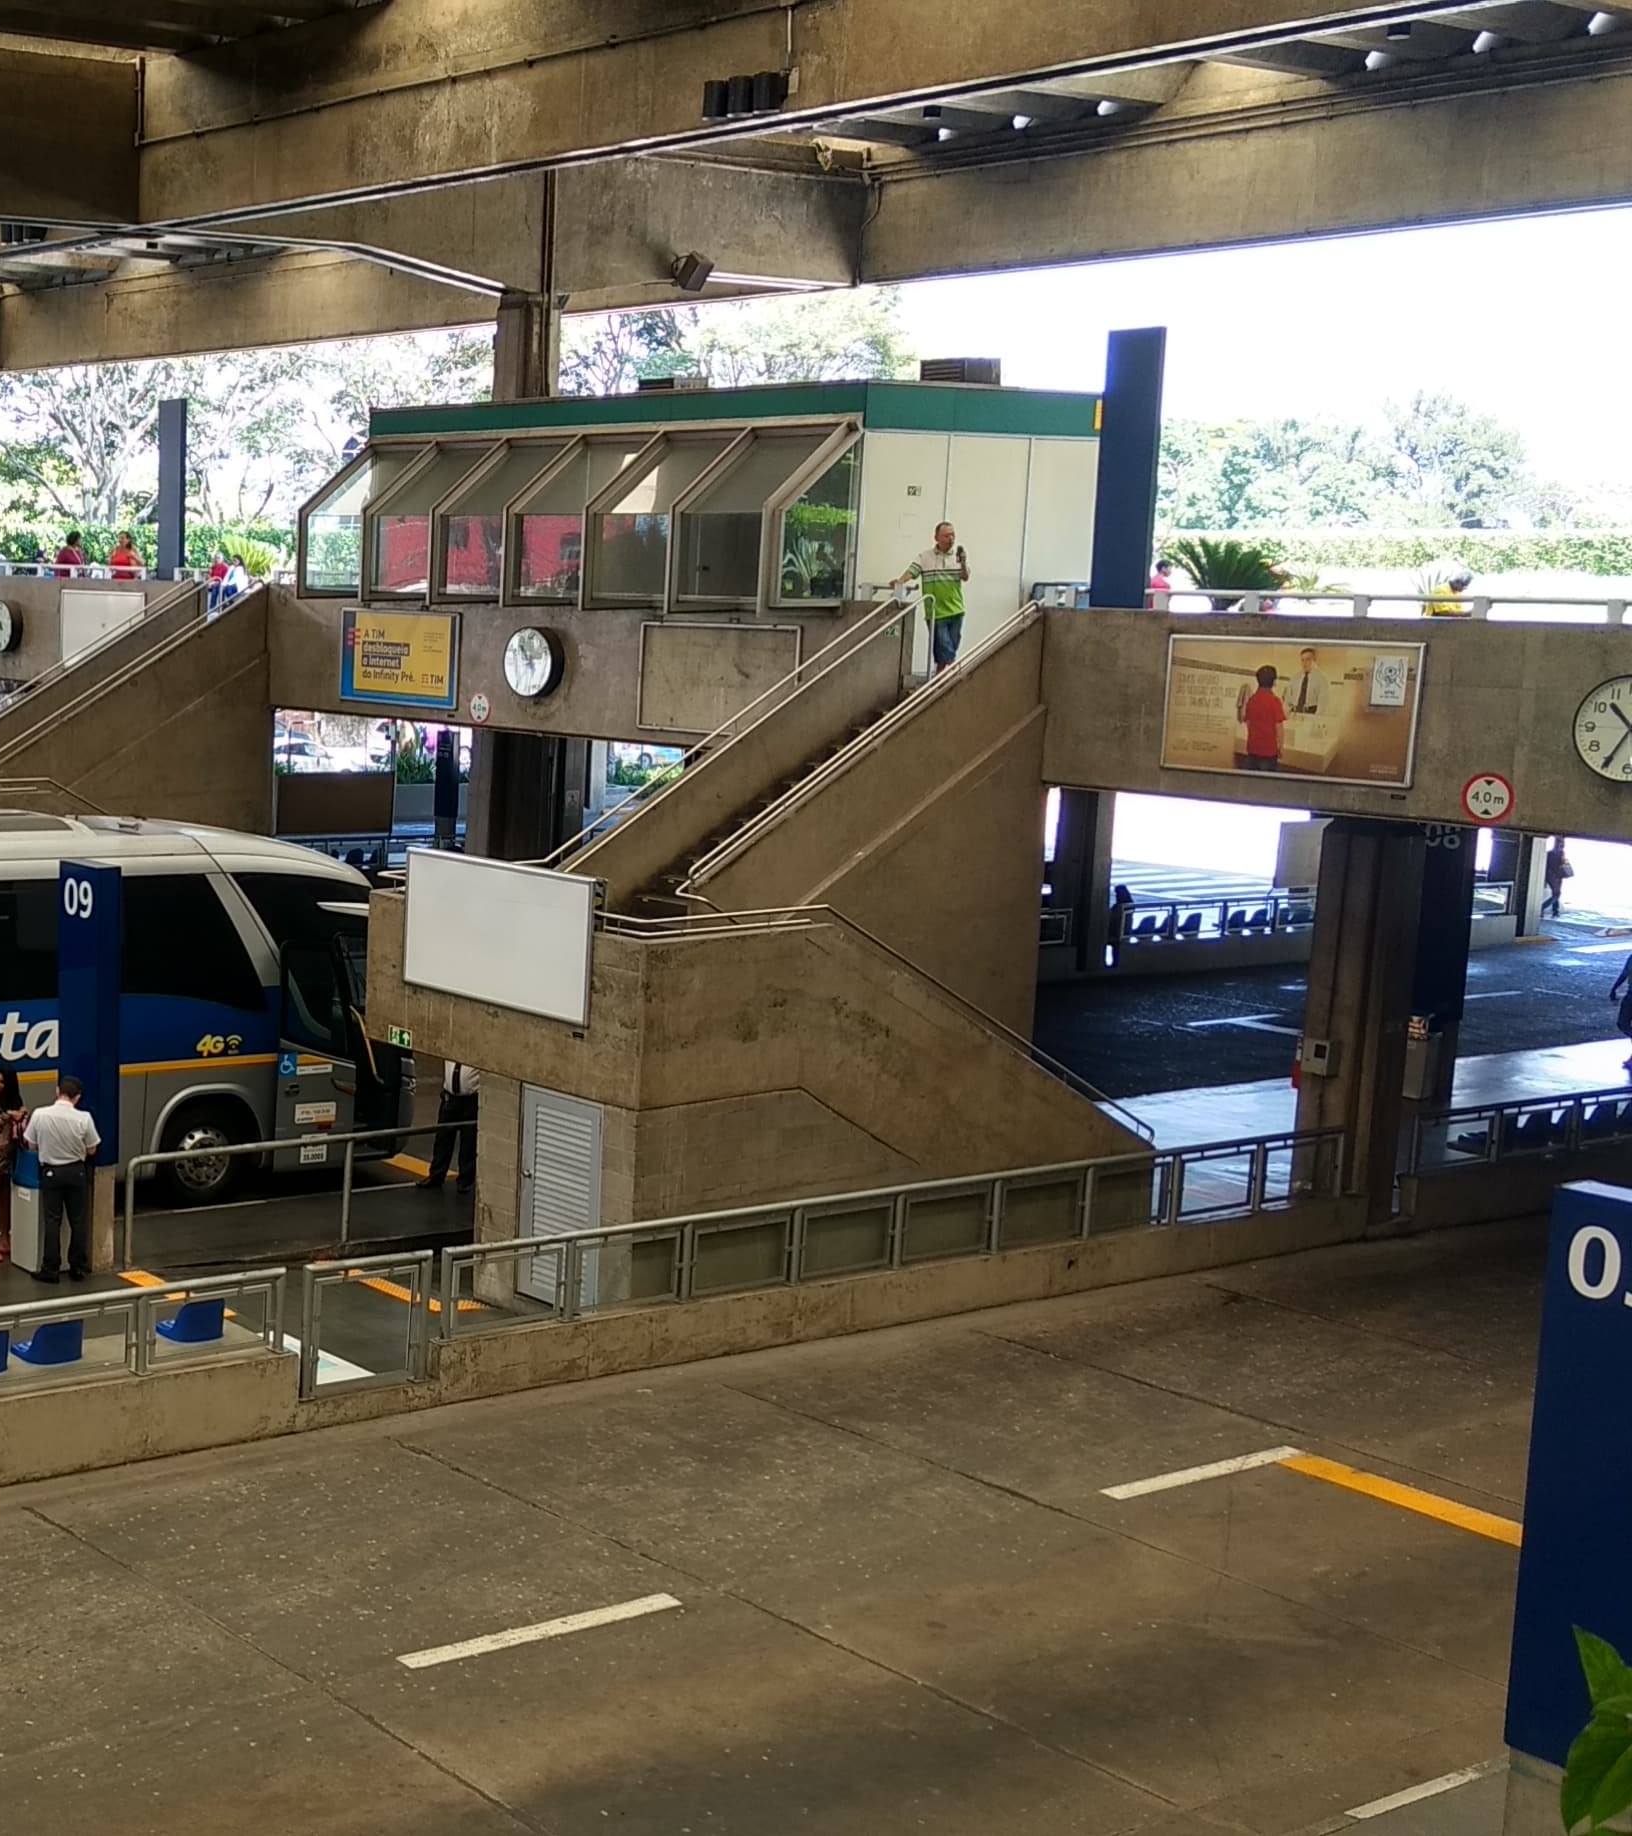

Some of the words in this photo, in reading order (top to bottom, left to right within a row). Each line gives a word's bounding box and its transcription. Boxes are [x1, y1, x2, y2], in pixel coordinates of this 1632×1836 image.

[371, 629, 386, 640] TIM
[362, 669, 372, 679] do
[373, 670, 399, 683] Infinity
[430, 674, 444, 684] TIM
[1611, 688, 1622, 701] 11
[1593, 702, 1608, 714] 10
[1584, 721, 1596, 733] 9
[1588, 740, 1600, 752] 8
[64, 877, 93, 918] 09
[196, 1034, 225, 1057] 4G
